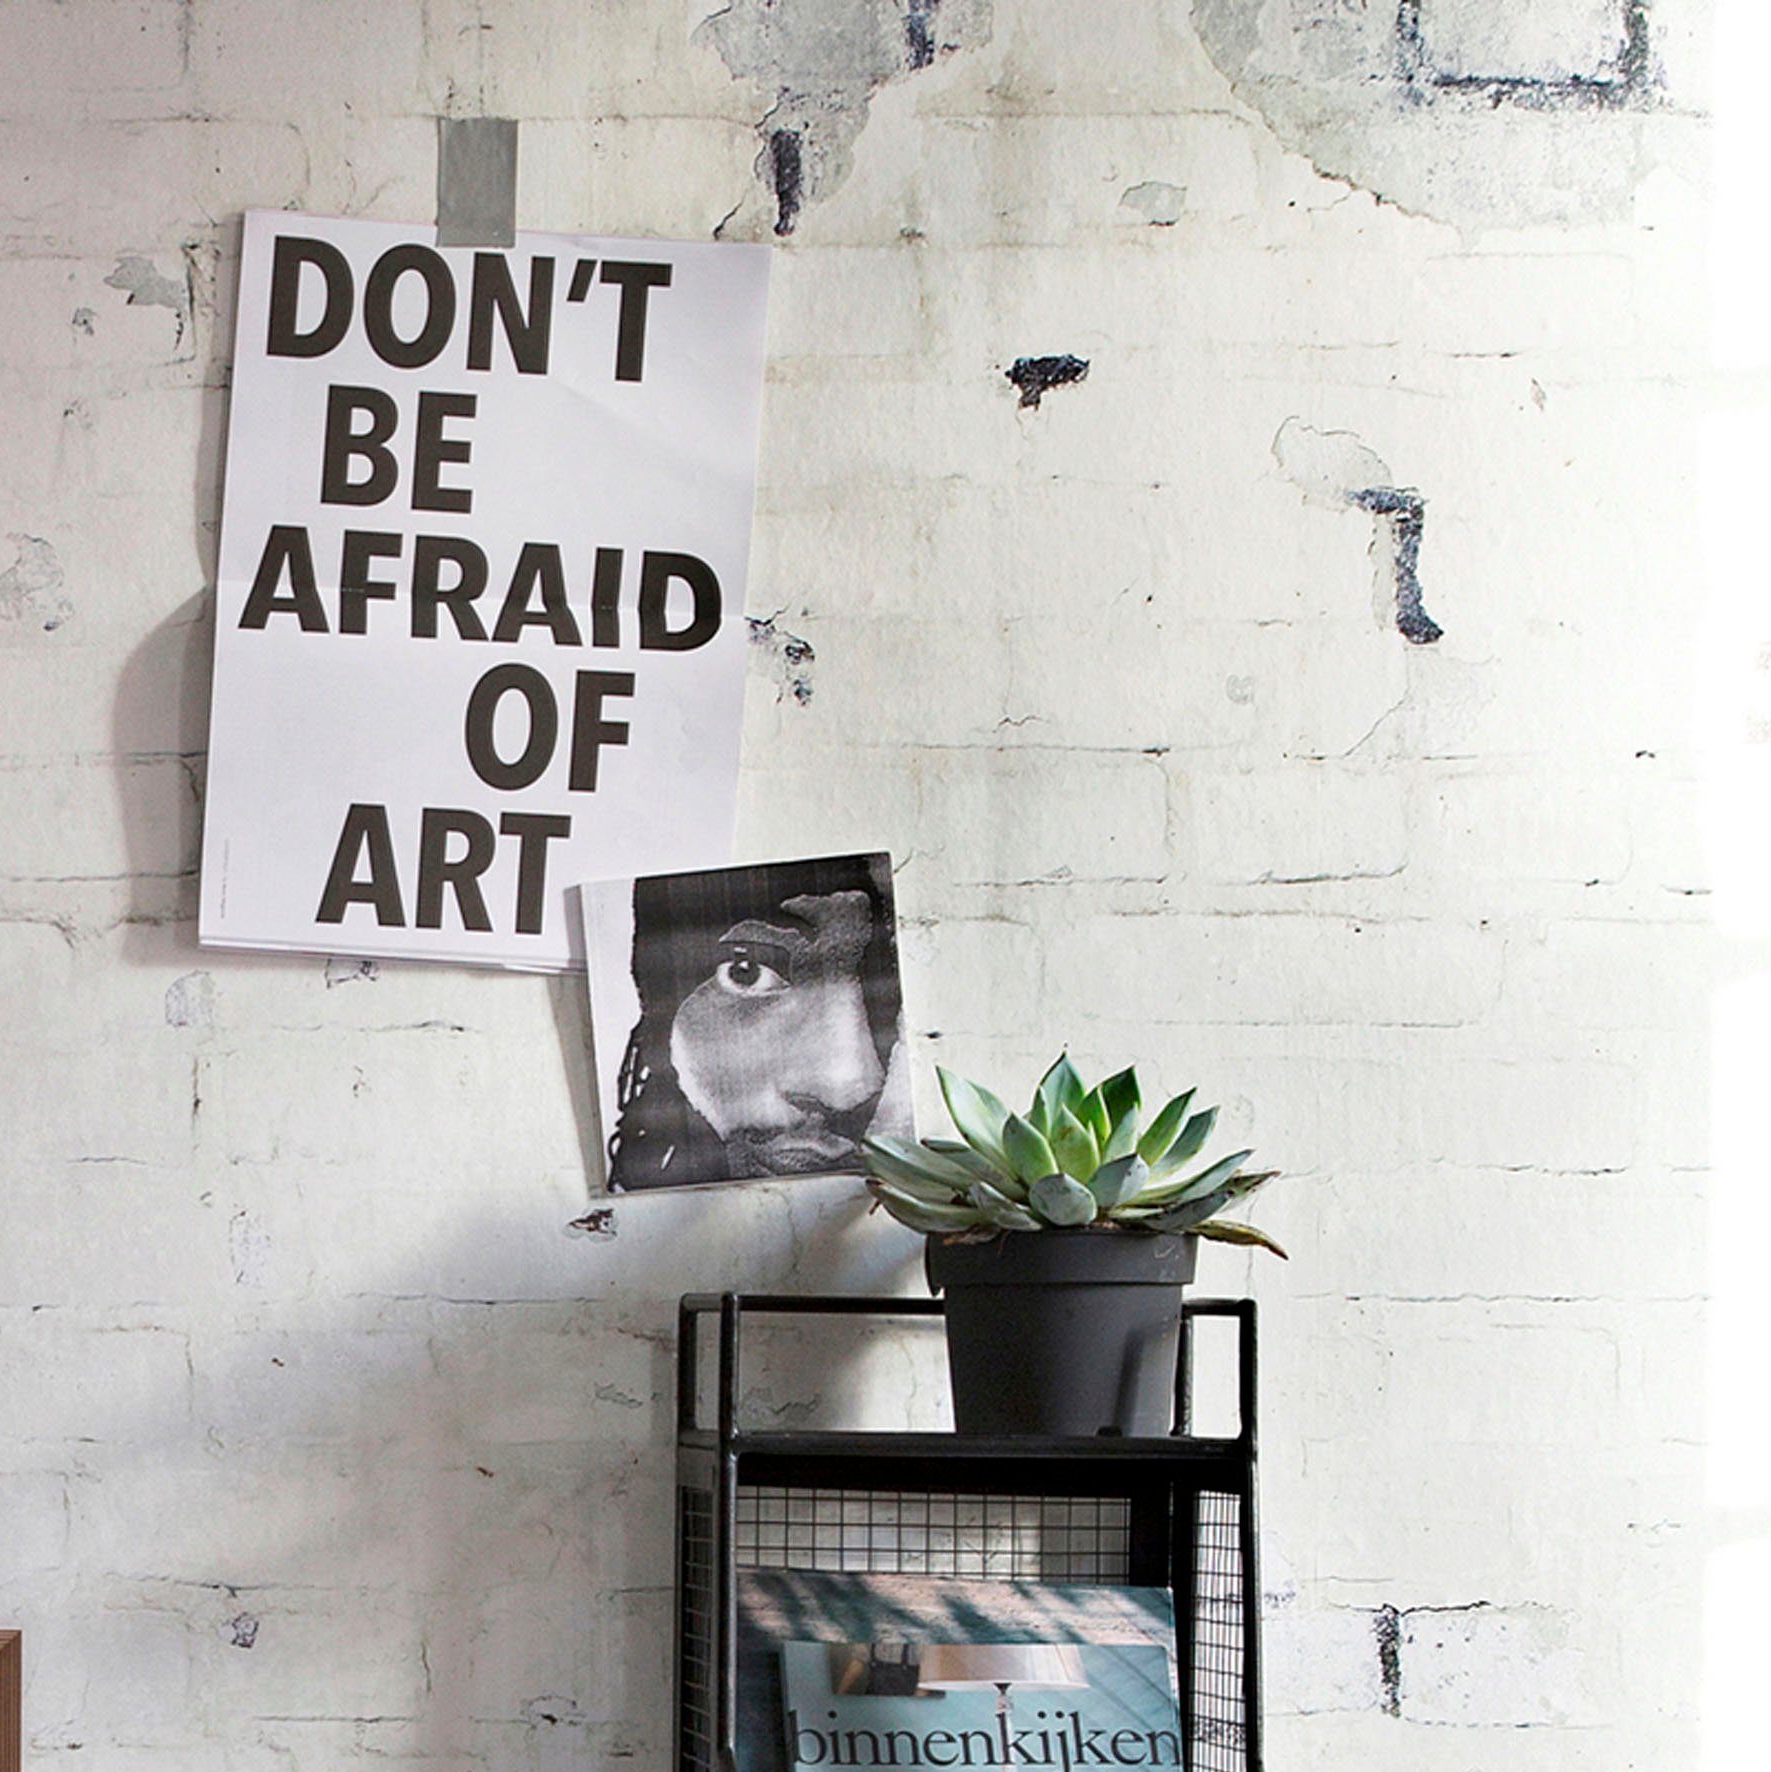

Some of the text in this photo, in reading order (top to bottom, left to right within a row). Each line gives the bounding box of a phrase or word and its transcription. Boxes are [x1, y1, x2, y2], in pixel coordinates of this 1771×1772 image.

[265, 234, 672, 382] DON'T
[319, 384, 478, 514] BE
[238, 525, 722, 652] AFRAID
[464, 662, 636, 793] OF
[315, 803, 571, 935] ART
